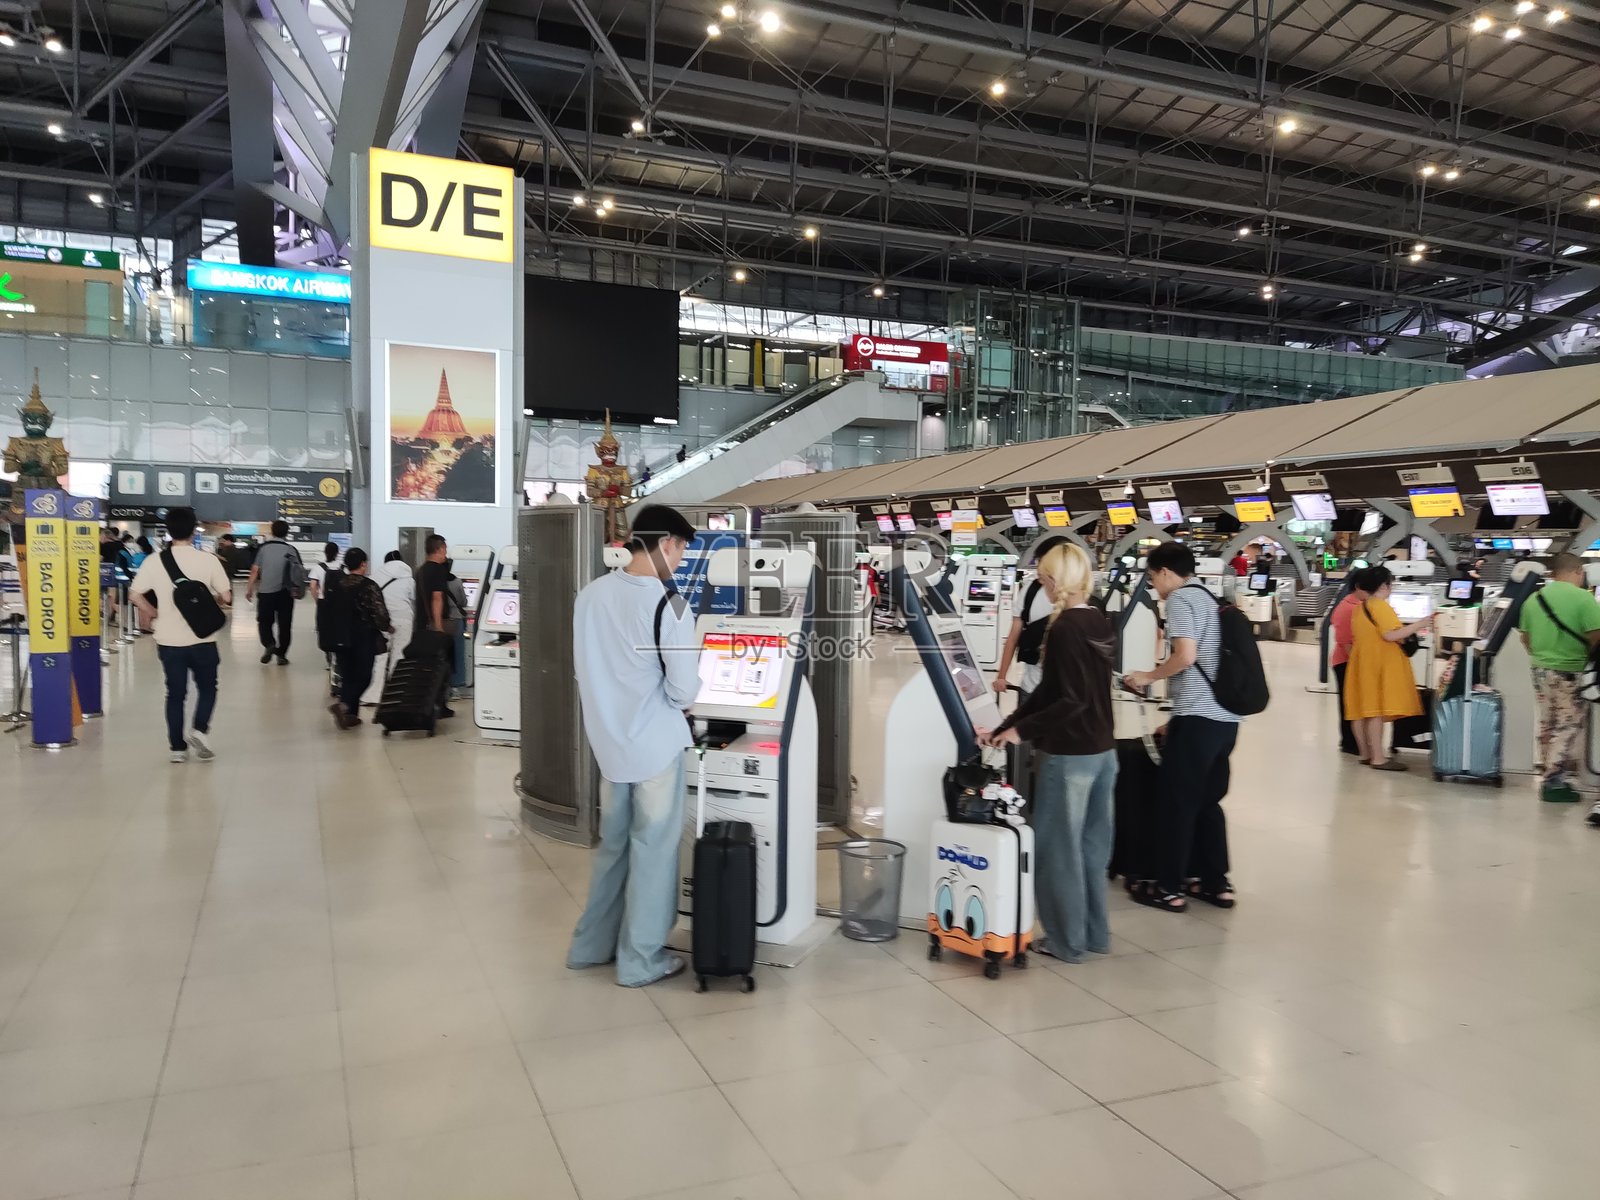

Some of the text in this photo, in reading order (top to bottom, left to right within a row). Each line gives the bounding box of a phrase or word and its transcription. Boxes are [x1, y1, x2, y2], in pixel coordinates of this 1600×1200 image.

[381, 172, 503, 241] D/E
[210, 269, 351, 299] BANGKOK AIRWAY
[40, 562, 54, 592] BAG
[78, 558, 90, 585] BAG
[41, 597, 55, 640] DROP
[78, 588, 91, 626] DROP
